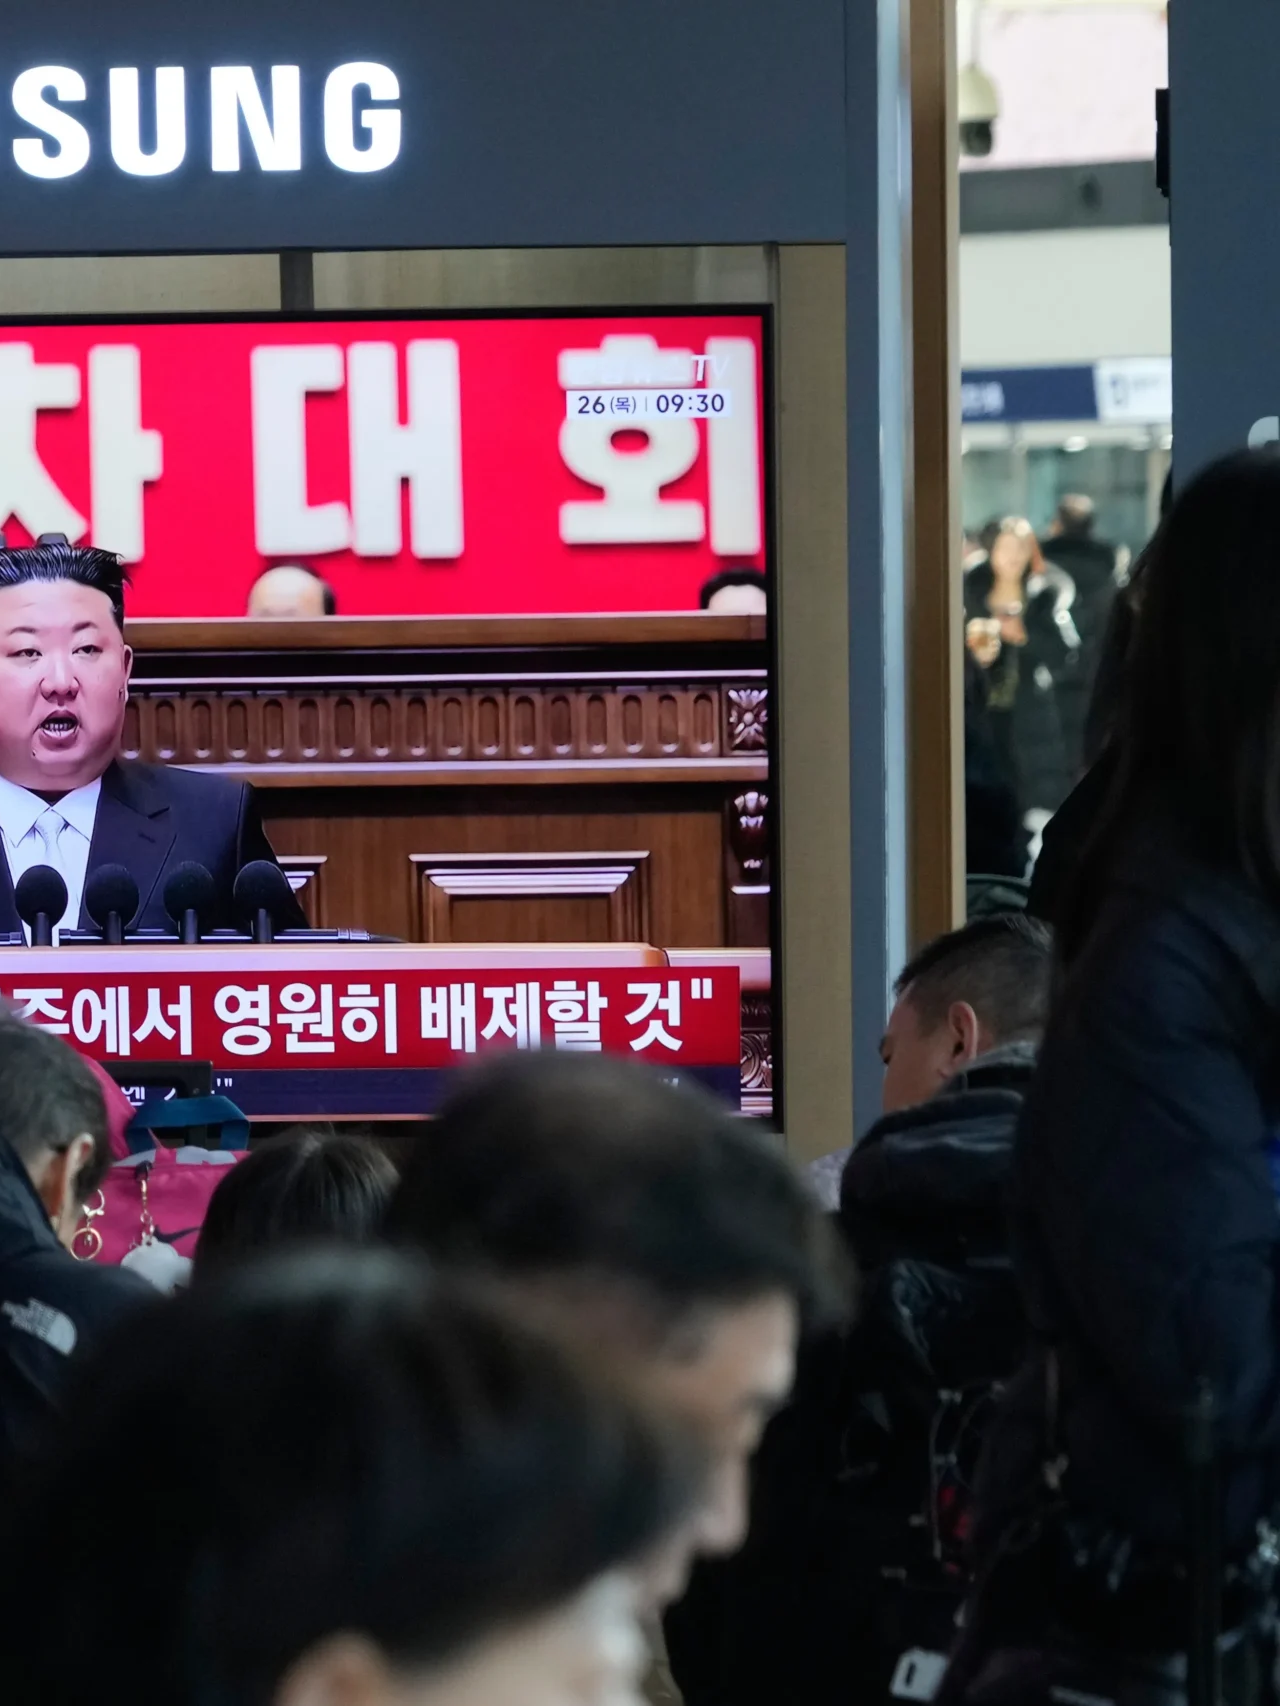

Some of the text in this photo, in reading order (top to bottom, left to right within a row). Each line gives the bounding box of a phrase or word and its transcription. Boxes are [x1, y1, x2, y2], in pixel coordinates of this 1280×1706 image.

[656, 393, 725, 413] 09:30
[213, 982, 399, 1057] 영원히
[420, 980, 608, 1053] 배제할
[624, 977, 713, 1052] 것"
